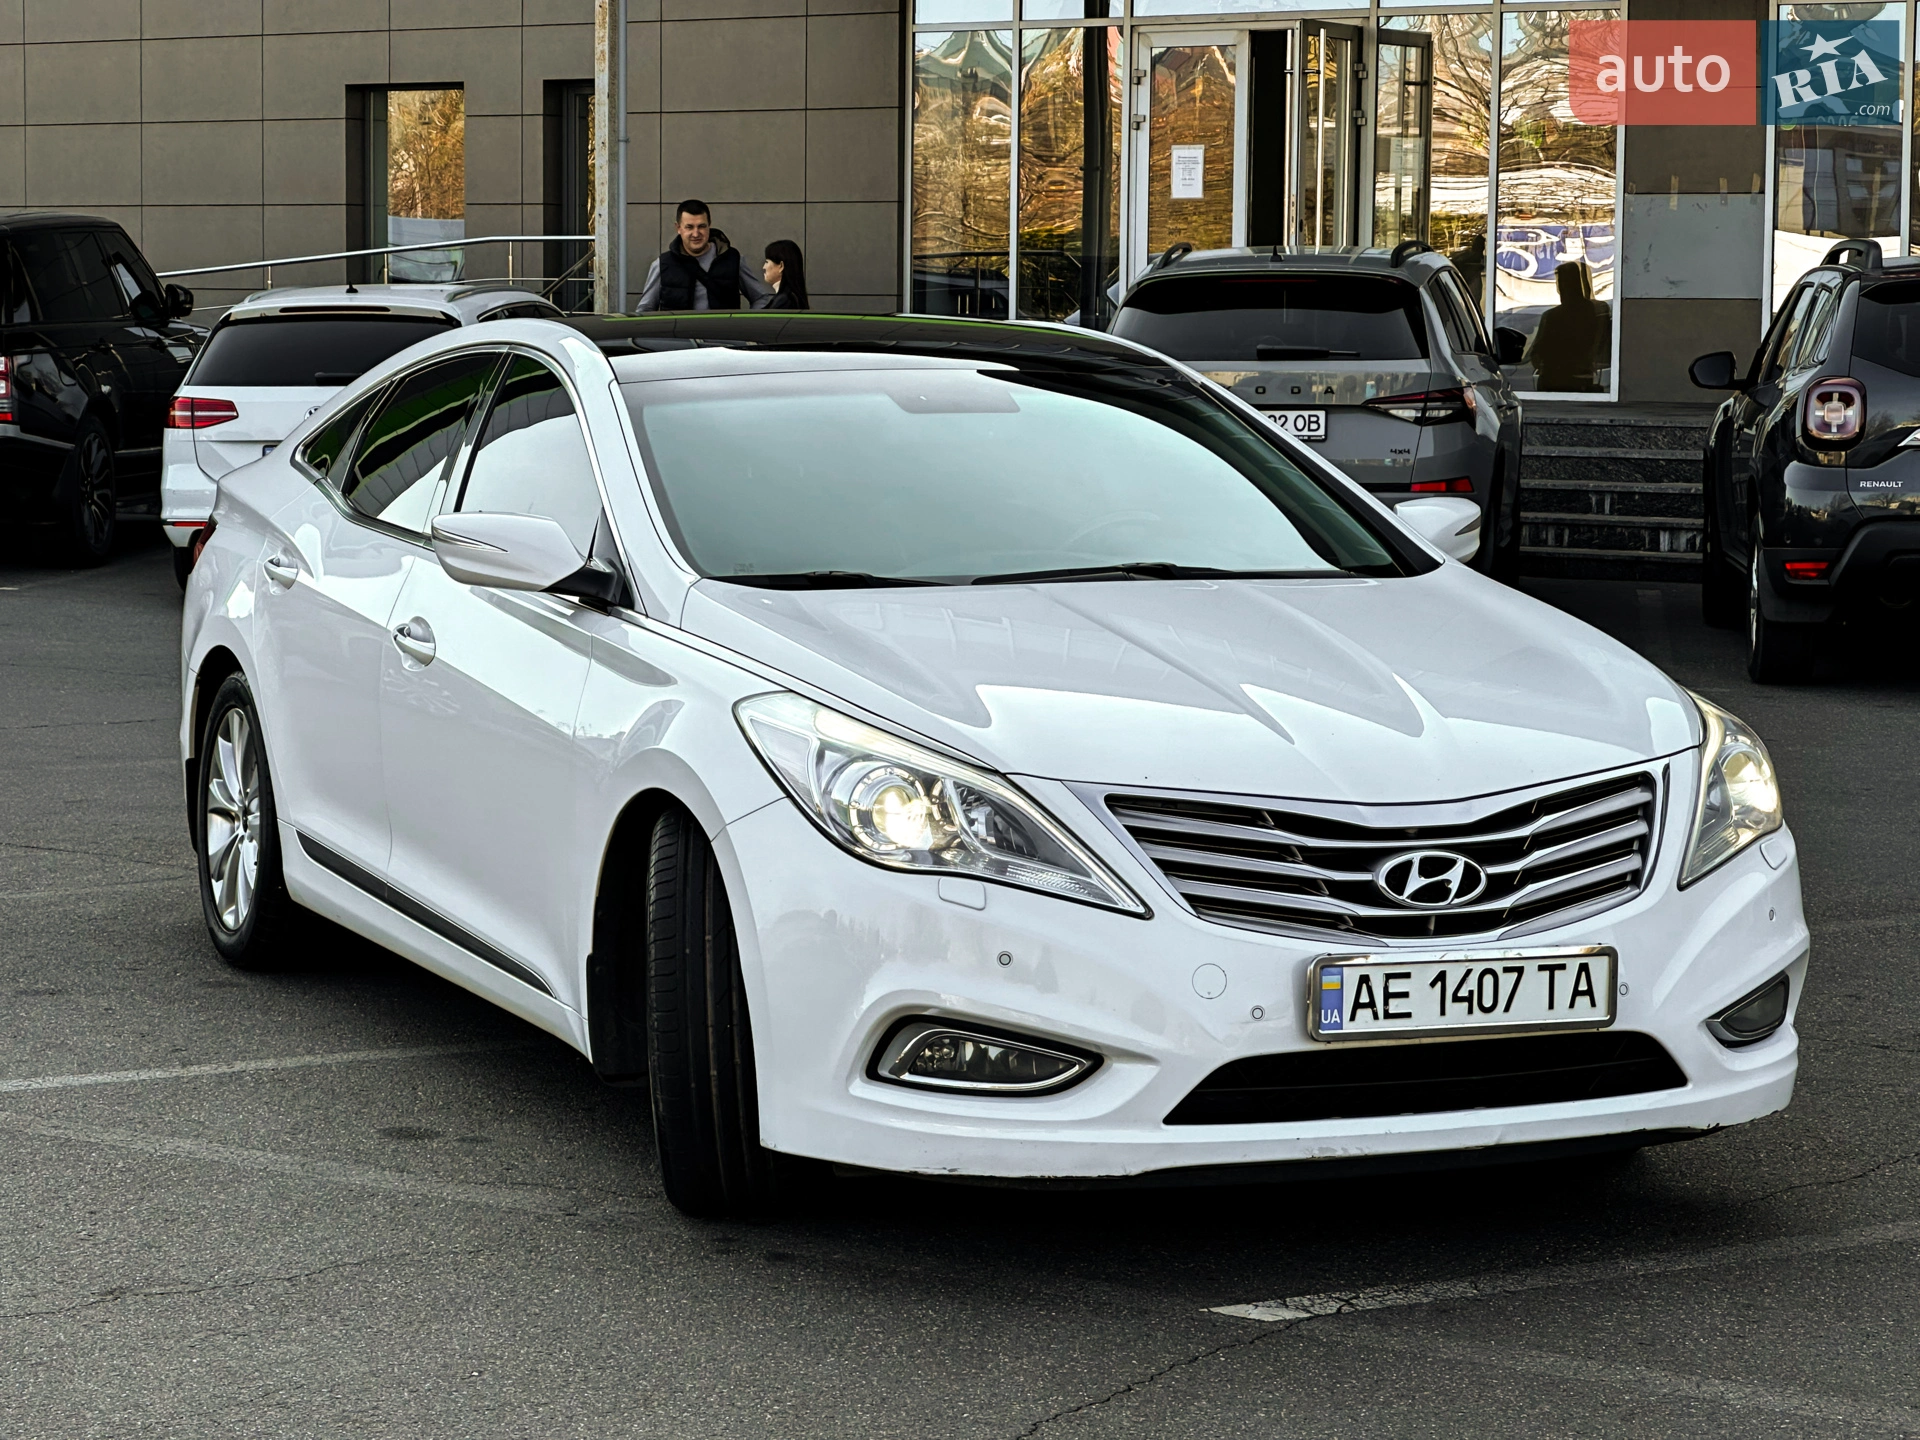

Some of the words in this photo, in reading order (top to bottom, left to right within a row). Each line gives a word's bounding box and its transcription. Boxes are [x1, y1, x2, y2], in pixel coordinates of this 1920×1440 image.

[1226, 385, 1335, 395] ODA
[1294, 414, 1321, 432] OB
[1860, 480, 1904, 488] RENAULT
[1349, 972, 1412, 1022] AE
[1429, 965, 1525, 1016] 1407
[1537, 962, 1597, 1010] TA
[1321, 1009, 1341, 1024] UA
